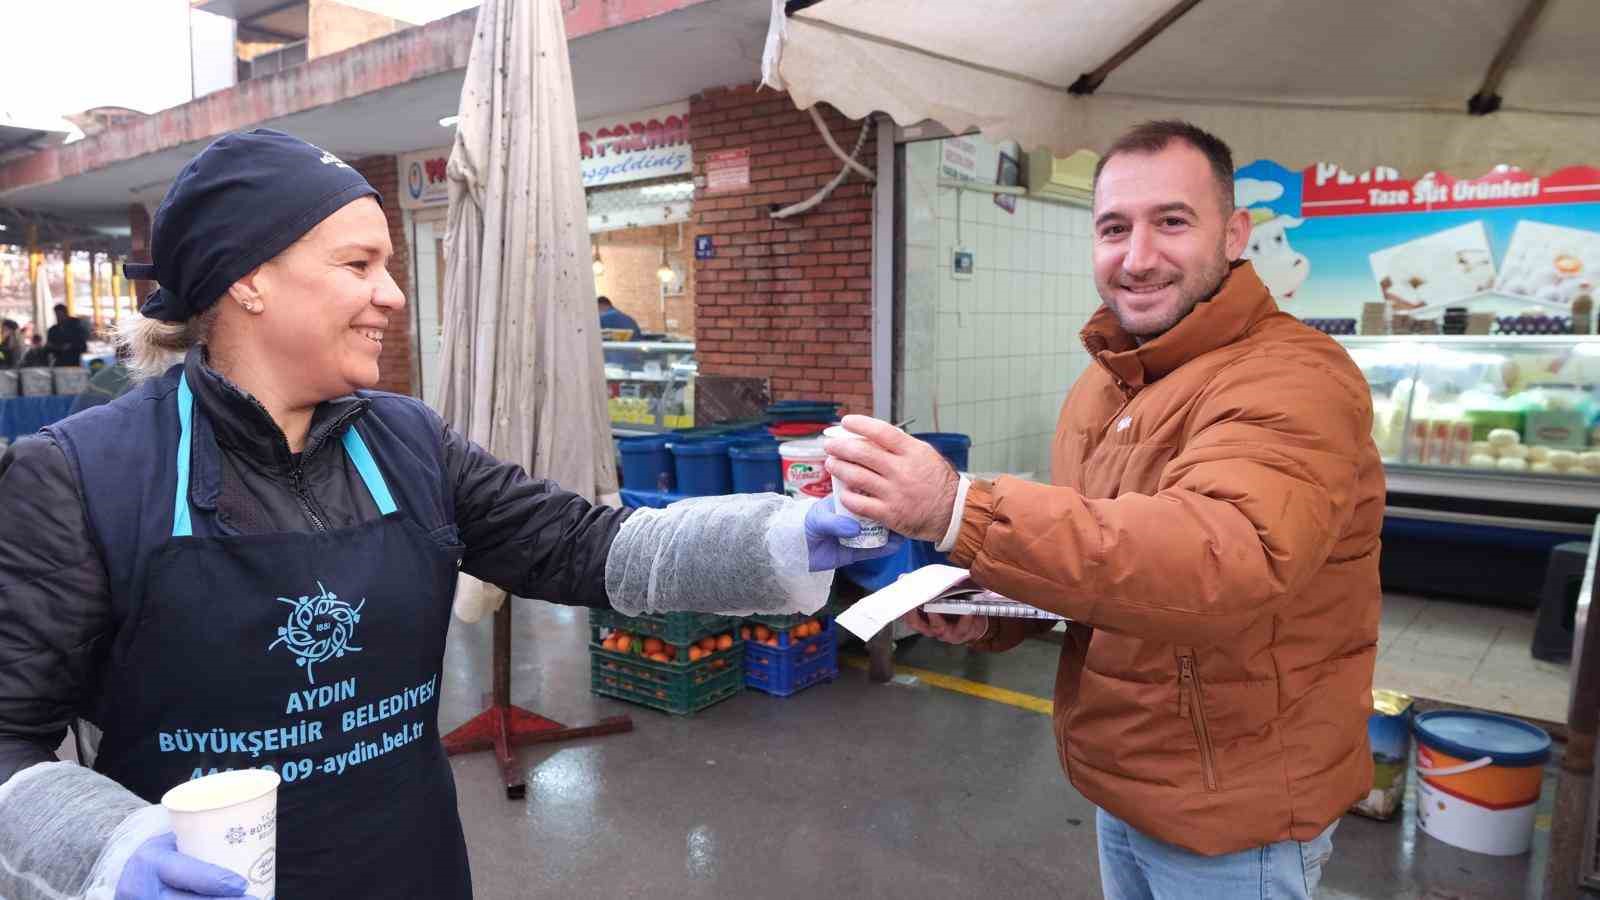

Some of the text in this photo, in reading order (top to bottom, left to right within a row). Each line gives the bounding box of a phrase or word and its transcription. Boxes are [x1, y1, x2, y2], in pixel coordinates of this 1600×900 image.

[1368, 188, 1408, 206] Taze
[286, 677, 356, 714] AYDIN
[159, 673, 437, 758] BÜYÜKŞEHİR BELEDİYESİ
